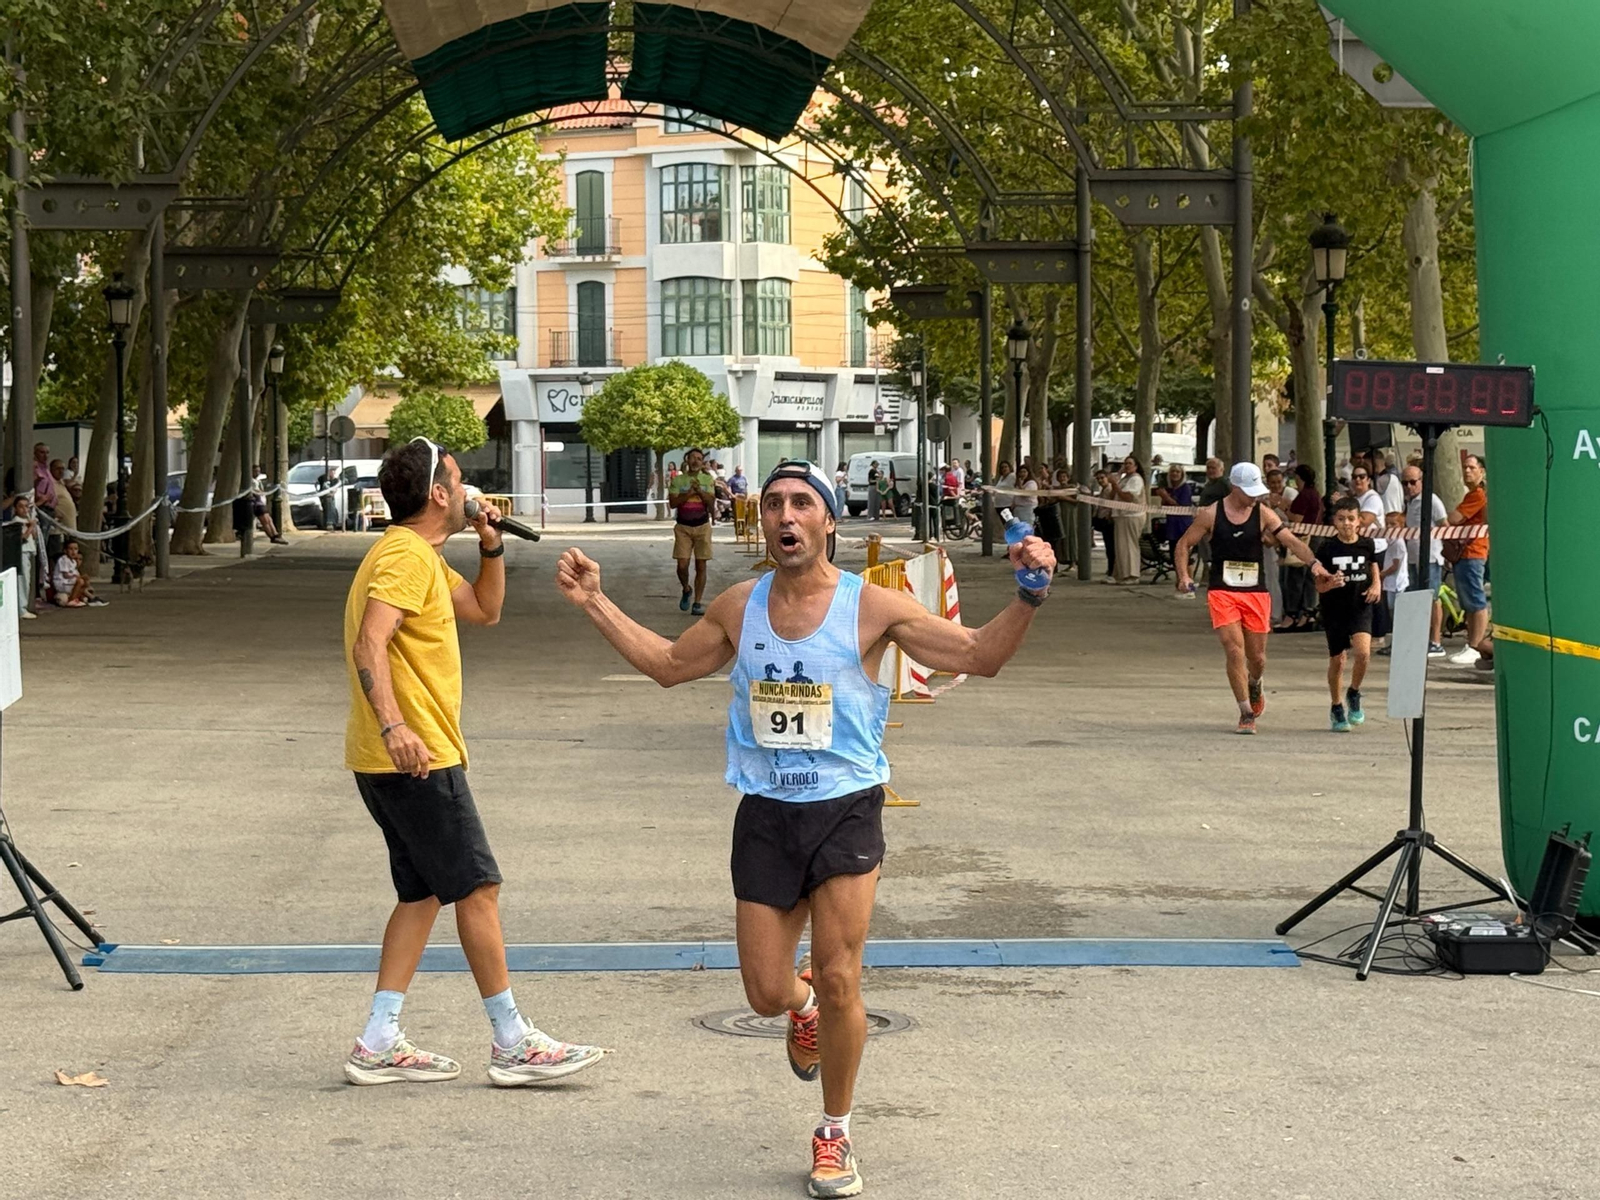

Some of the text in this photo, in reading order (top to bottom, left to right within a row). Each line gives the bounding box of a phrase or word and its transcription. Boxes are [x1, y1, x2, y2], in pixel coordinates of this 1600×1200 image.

[1572, 429, 1600, 470] A
[1238, 571, 1244, 581] 1
[760, 683, 784, 696] NUNCA
[791, 684, 822, 697] RINDAS
[771, 711, 804, 735] 91
